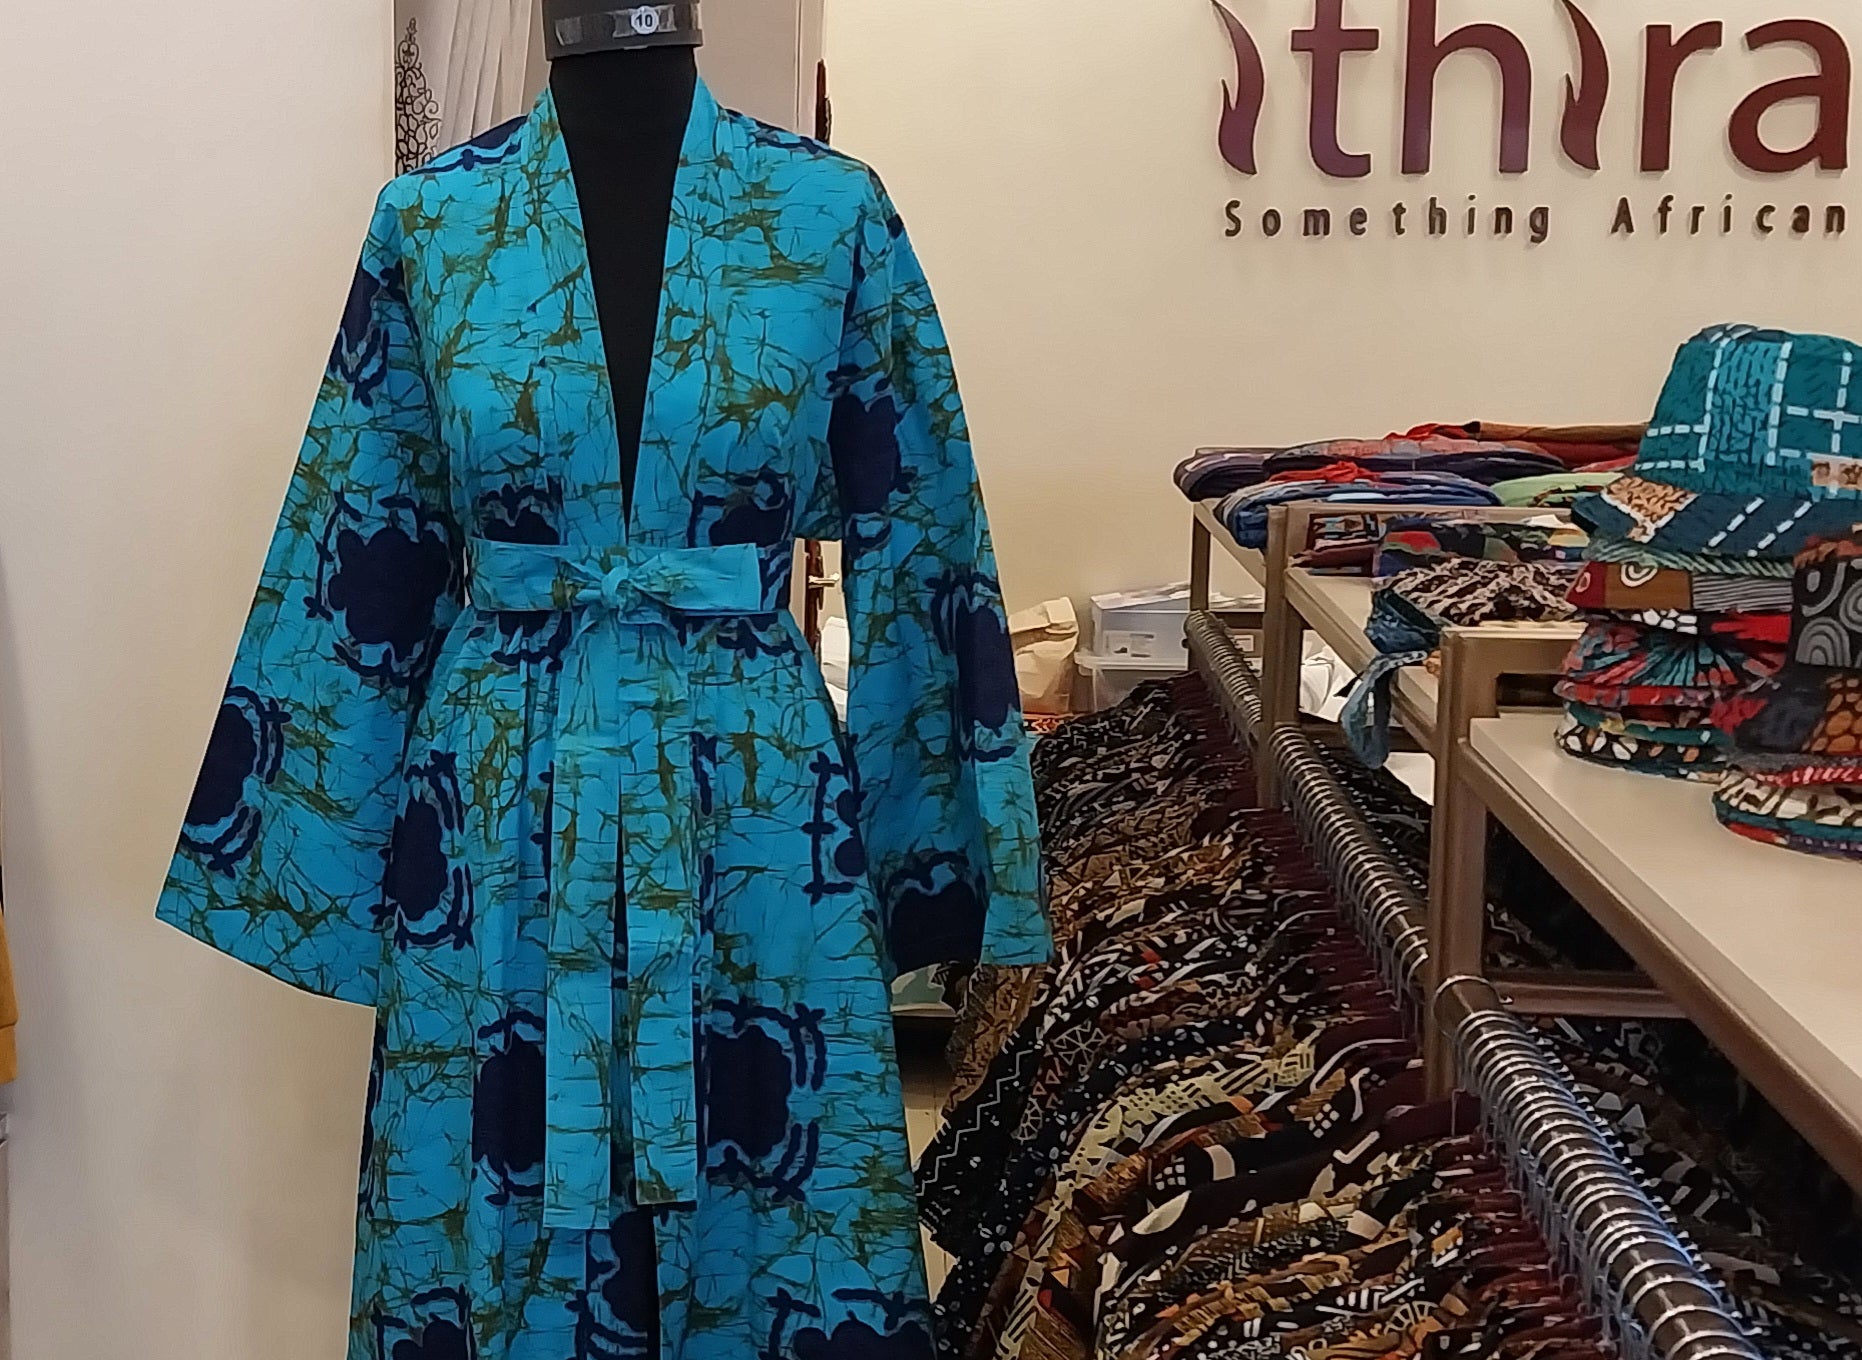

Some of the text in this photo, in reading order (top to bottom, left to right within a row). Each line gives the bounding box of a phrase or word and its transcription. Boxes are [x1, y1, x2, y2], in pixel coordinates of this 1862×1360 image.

[636, 14, 653, 27] 10
[1223, 194, 1847, 244] Something African
